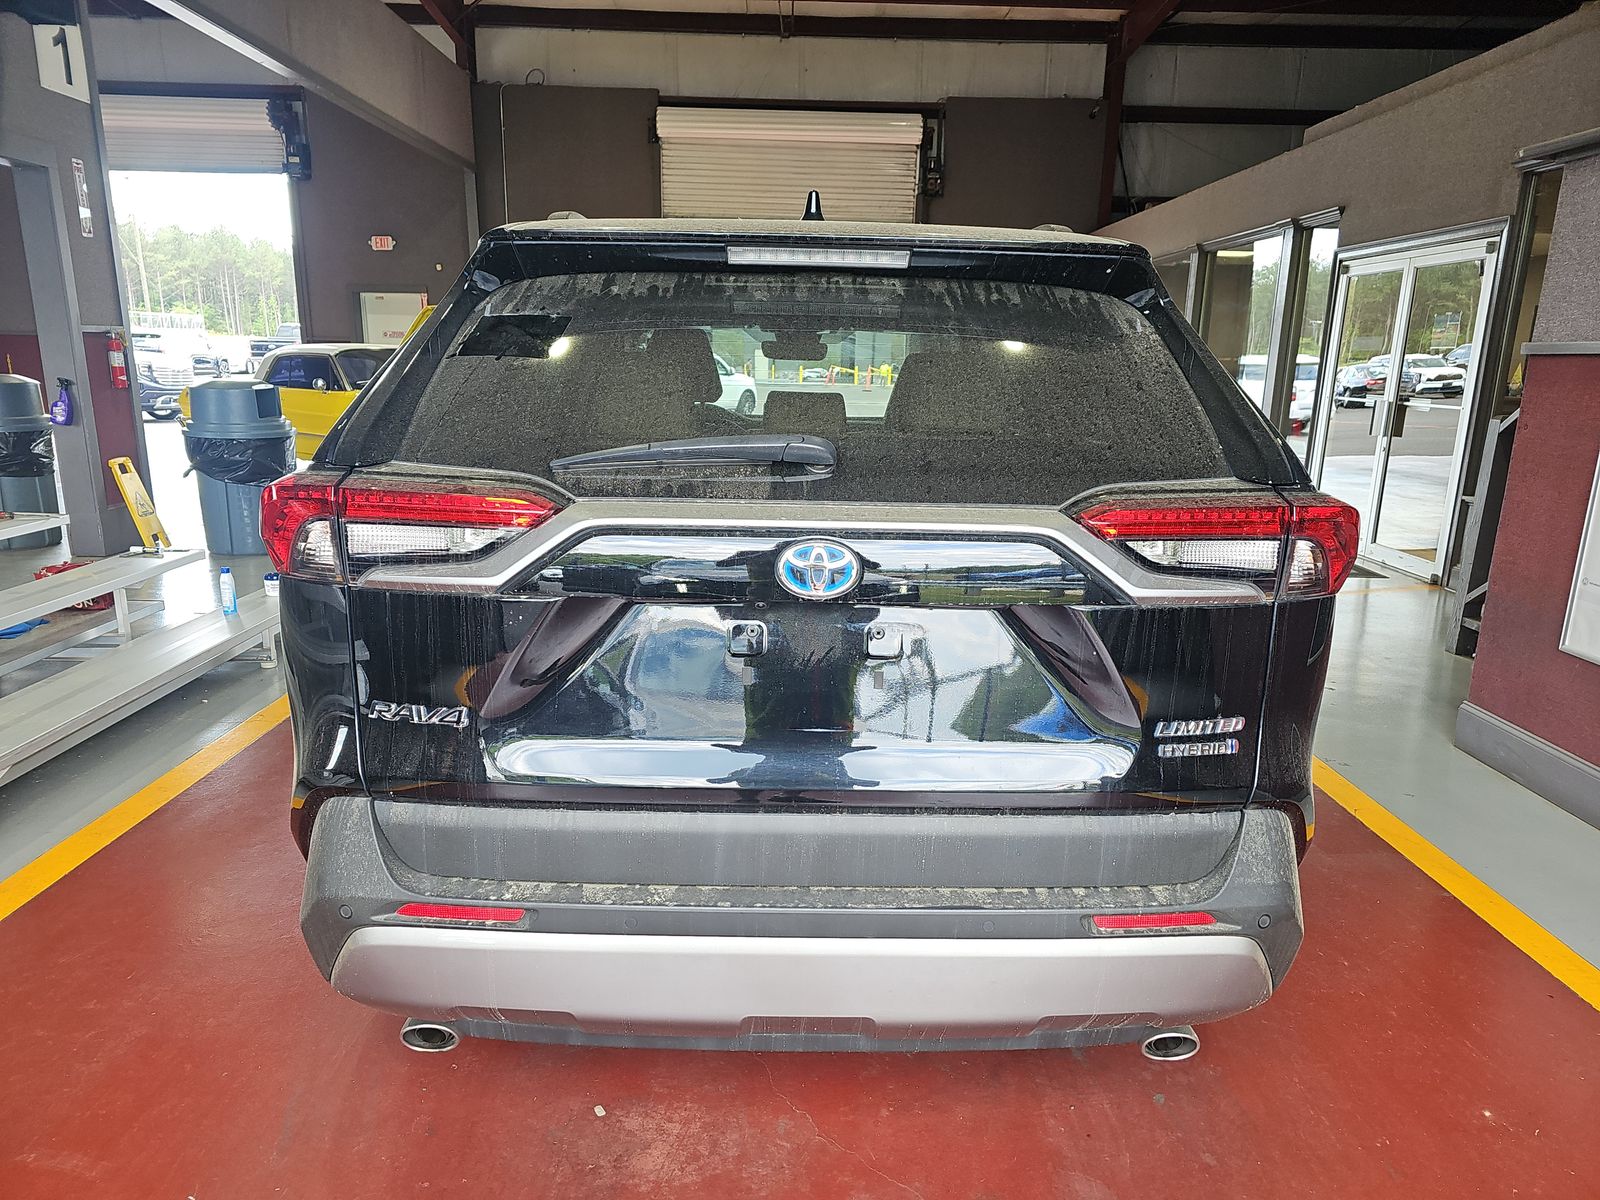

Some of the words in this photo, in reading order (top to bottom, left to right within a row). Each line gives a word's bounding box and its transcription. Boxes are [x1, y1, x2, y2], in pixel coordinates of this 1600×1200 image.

[51, 26, 73, 86] 1
[374, 237, 389, 249] EXIT
[368, 700, 469, 728] RAV4
[1154, 716, 1246, 738] LIMITED
[1159, 740, 1232, 758] HYBRID
